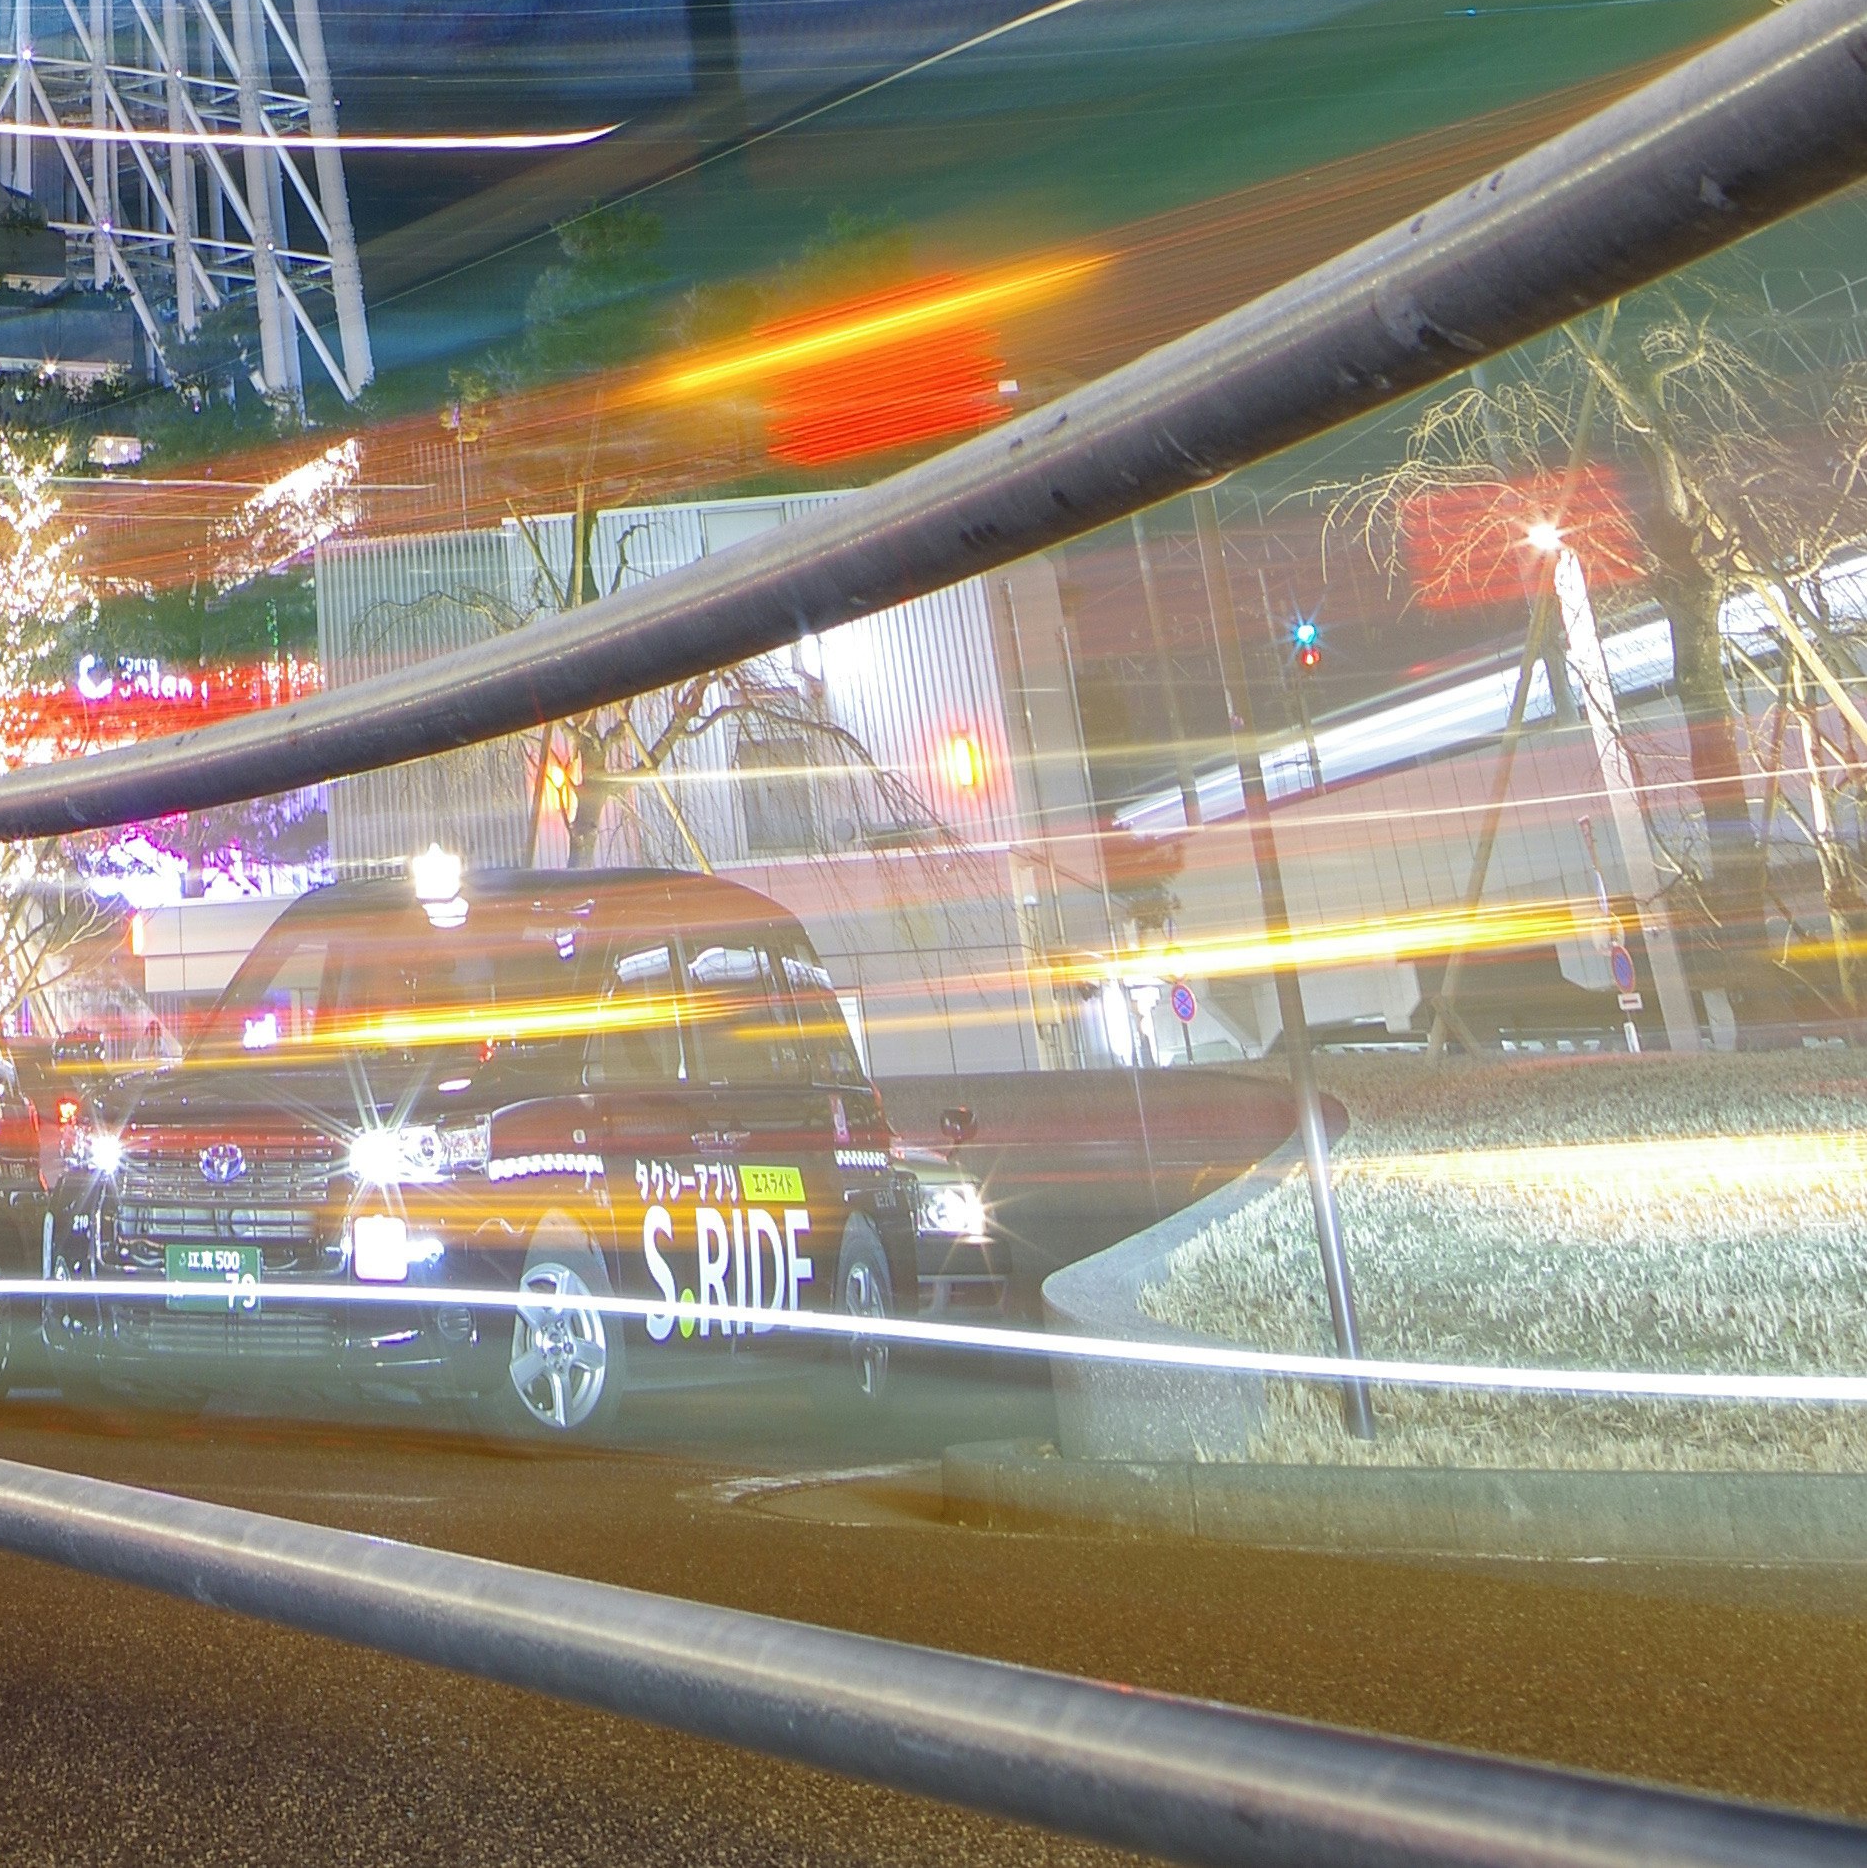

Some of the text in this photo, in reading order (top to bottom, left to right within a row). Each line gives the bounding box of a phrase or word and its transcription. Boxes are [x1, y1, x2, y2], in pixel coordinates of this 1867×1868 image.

[635, 1159, 793, 1202] タクシーアプリ エスライド
[216, 1250, 240, 1271] 500
[643, 1205, 814, 1342] S.RIDE
